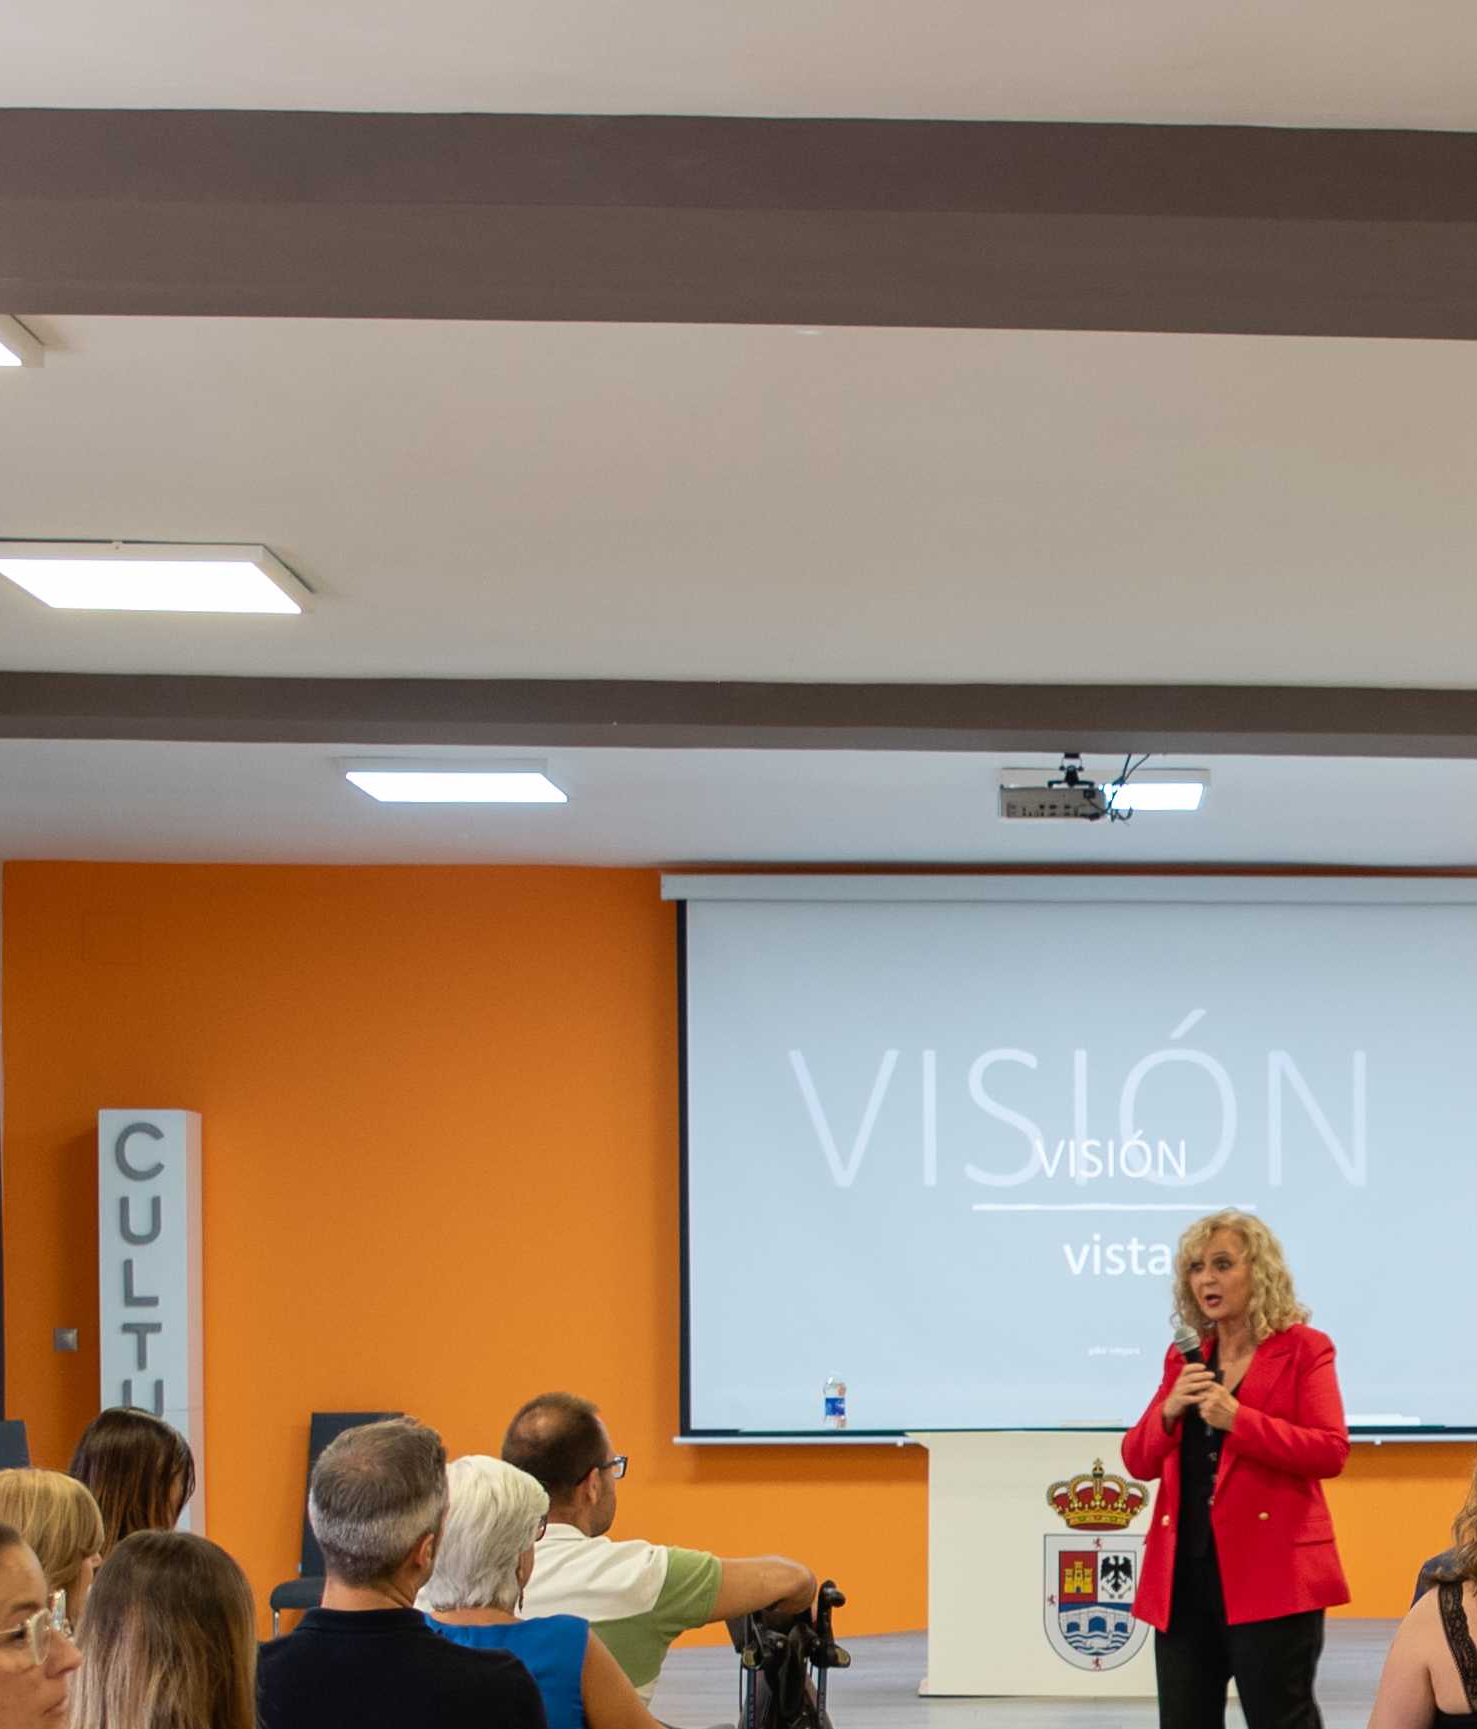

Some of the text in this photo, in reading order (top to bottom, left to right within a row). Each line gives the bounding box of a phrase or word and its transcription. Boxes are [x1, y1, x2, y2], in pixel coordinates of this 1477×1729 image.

[787, 1008, 1367, 1187] VISIÓN
[1034, 1129, 1187, 1179] VISIÓN
[1063, 1233, 1172, 1276] vista
